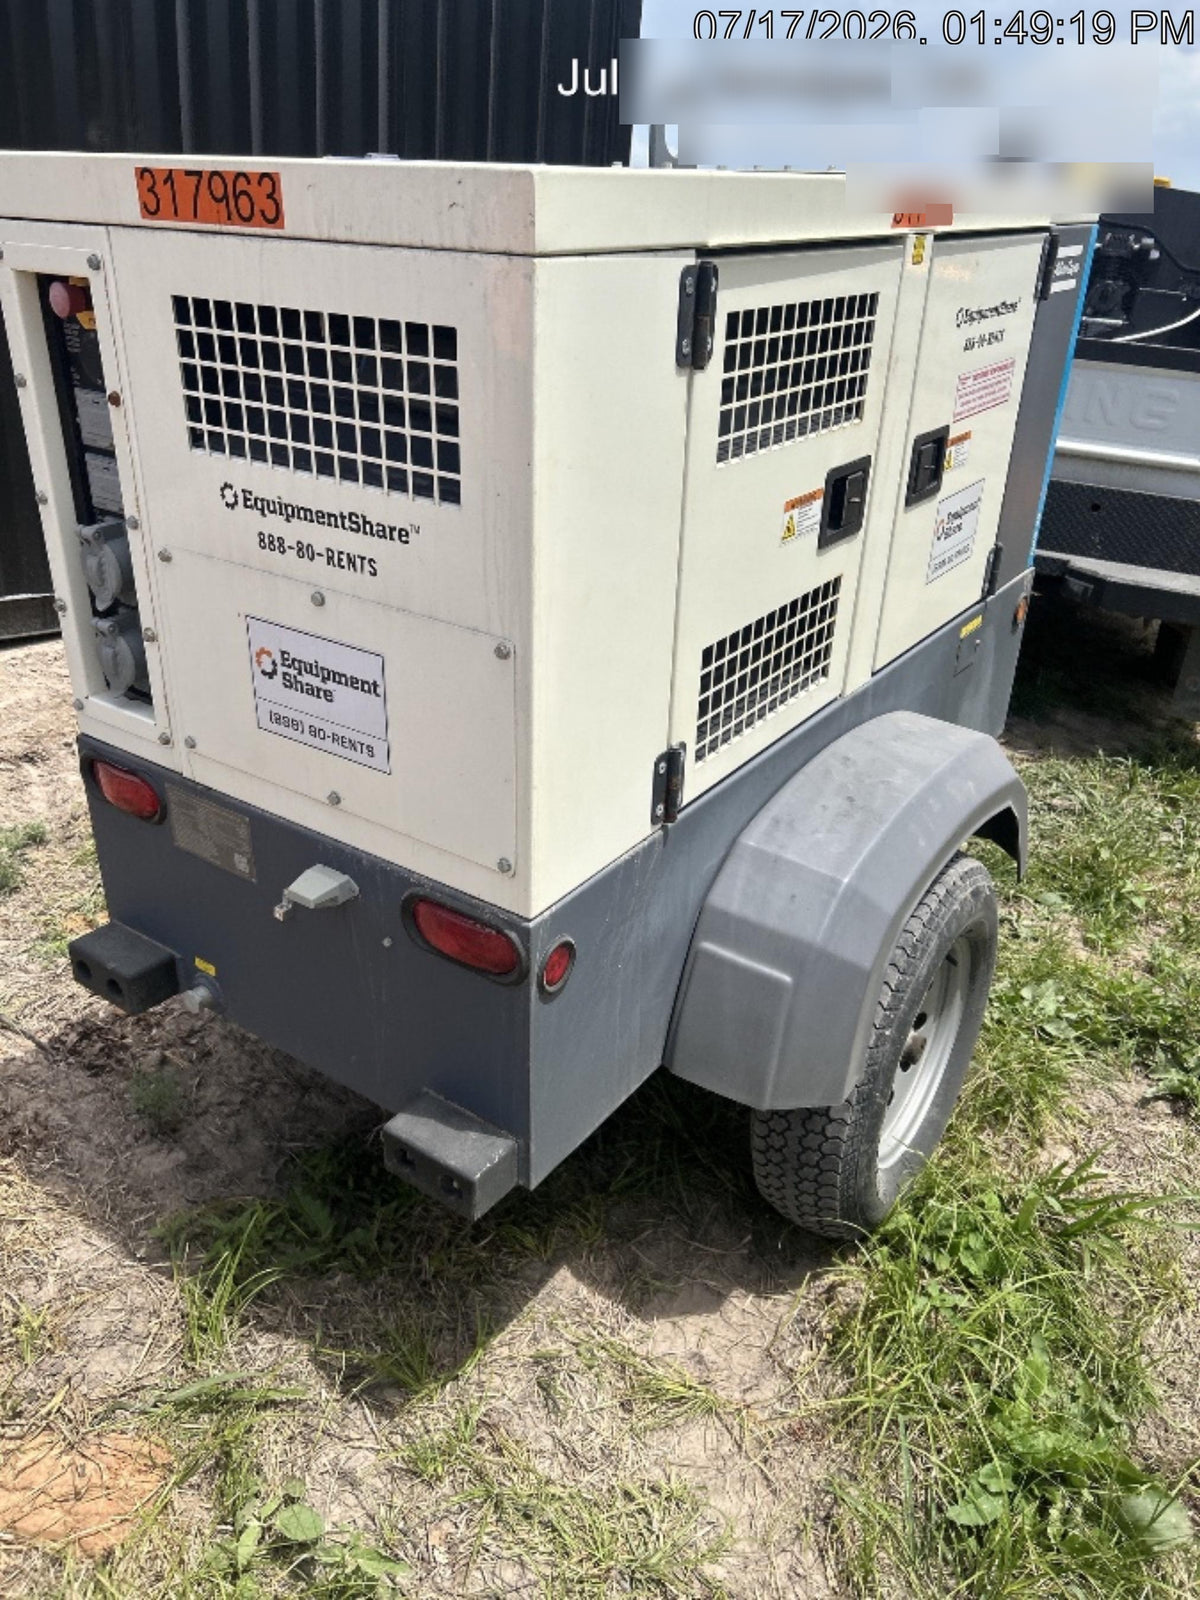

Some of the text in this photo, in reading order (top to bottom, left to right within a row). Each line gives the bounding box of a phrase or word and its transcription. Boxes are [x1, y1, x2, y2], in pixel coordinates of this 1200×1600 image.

[140, 167, 282, 224] 317963
[257, 531, 378, 577] 888-80-RENTS
[279, 648, 382, 698] Equipment
[282, 671, 335, 703] Share
[308, 724, 375, 758] 80-RENTS
